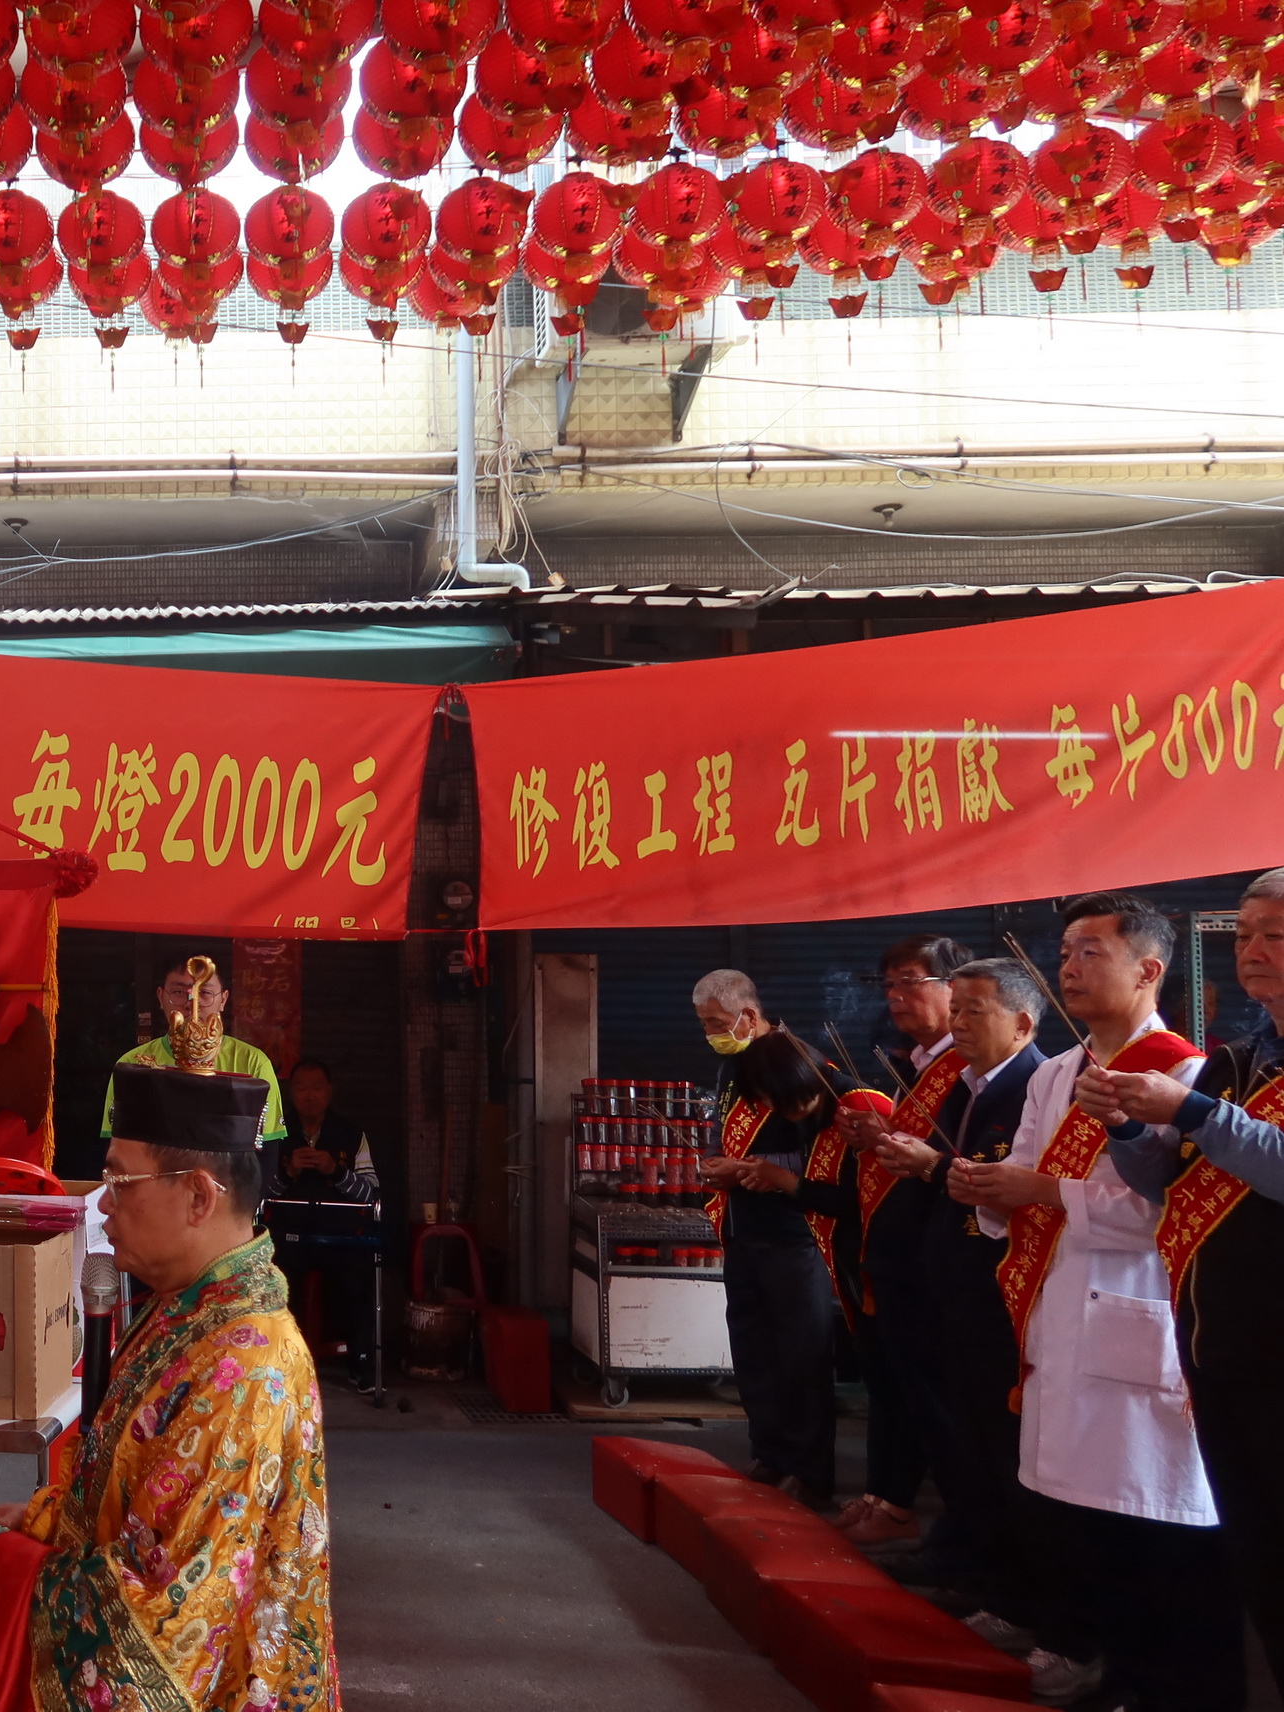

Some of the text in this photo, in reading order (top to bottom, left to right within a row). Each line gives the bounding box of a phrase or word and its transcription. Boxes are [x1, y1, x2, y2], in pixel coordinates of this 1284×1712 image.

[12, 728, 388, 886] 每燈2000元
[510, 751, 735, 879] 修復工程
[774, 717, 1014, 843] 瓦片捐獻
